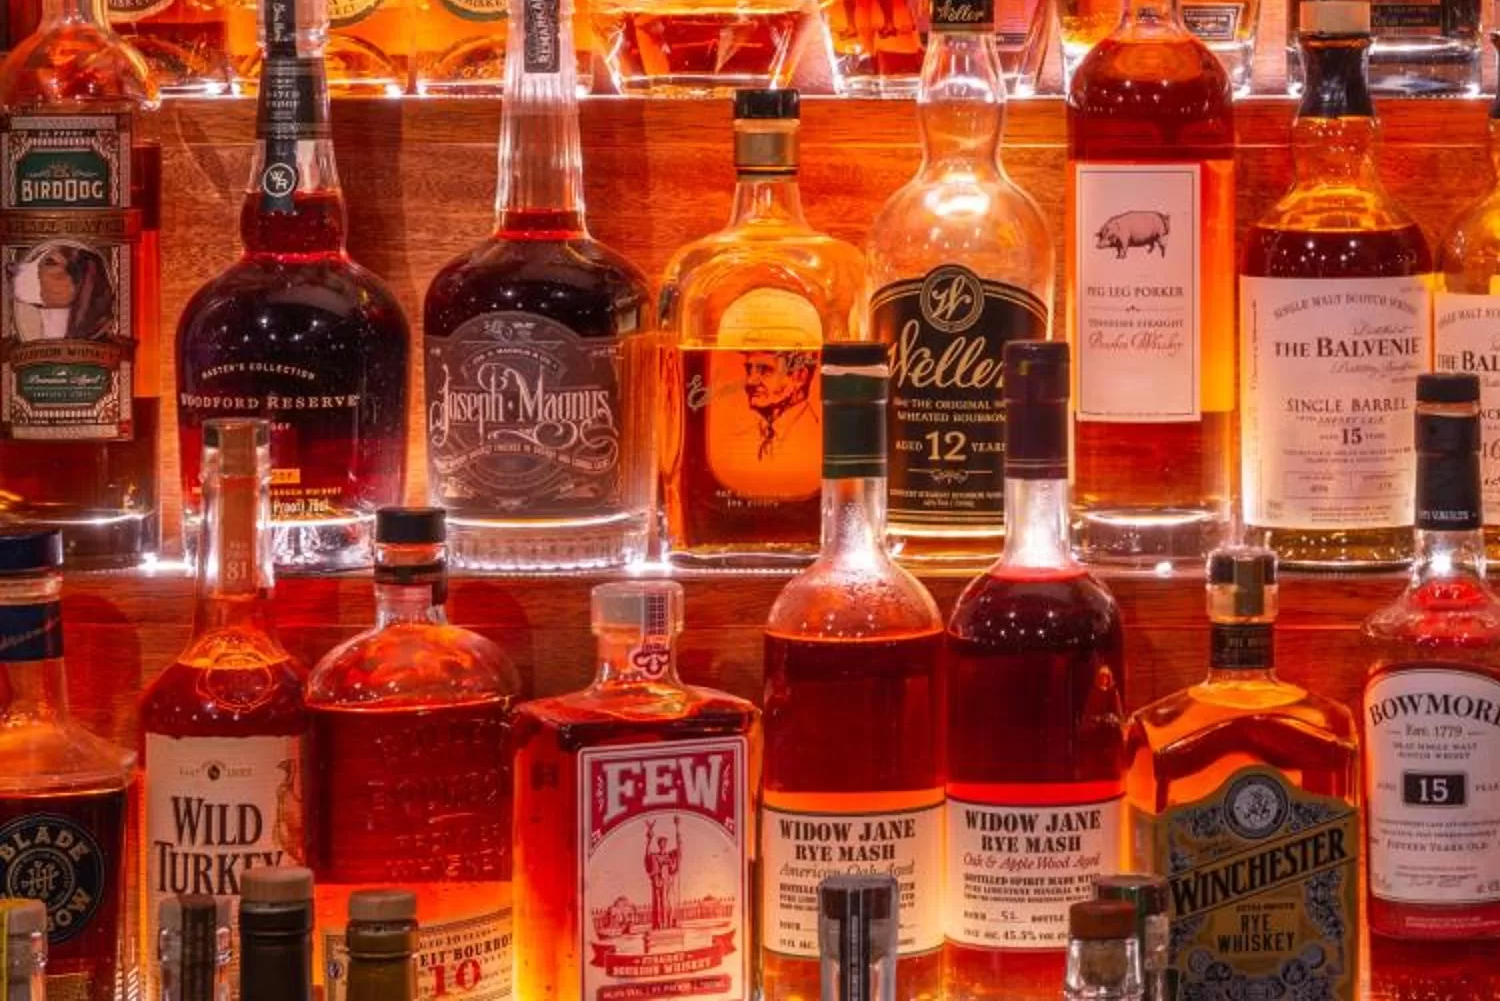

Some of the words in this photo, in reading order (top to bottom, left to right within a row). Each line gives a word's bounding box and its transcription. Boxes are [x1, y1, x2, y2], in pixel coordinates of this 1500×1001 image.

[1134, 285, 1184, 297] PORKER
[1317, 336, 1420, 358] BALVENIE
[267, 393, 361, 409] RESERVE
[1287, 398, 1342, 413] SINGLE
[1351, 398, 1409, 412] BARREL
[925, 431, 967, 461] 12
[1341, 428, 1363, 445] 15
[1417, 778, 1449, 801] 15
[171, 796, 263, 846] WILD
[780, 819, 851, 840] WIDOW
[858, 819, 916, 841] JANE
[965, 810, 1039, 831] WIDOW
[1045, 810, 1101, 830] JANE
[795, 845, 833, 861] RYE
[839, 845, 896, 861] MASH
[980, 835, 1021, 853] RYE
[1025, 835, 1081, 852] MASH
[1172, 827, 1346, 916] WINCHESTER
[1241, 913, 1271, 932] RYE
[1217, 933, 1295, 953] WHISKEY
